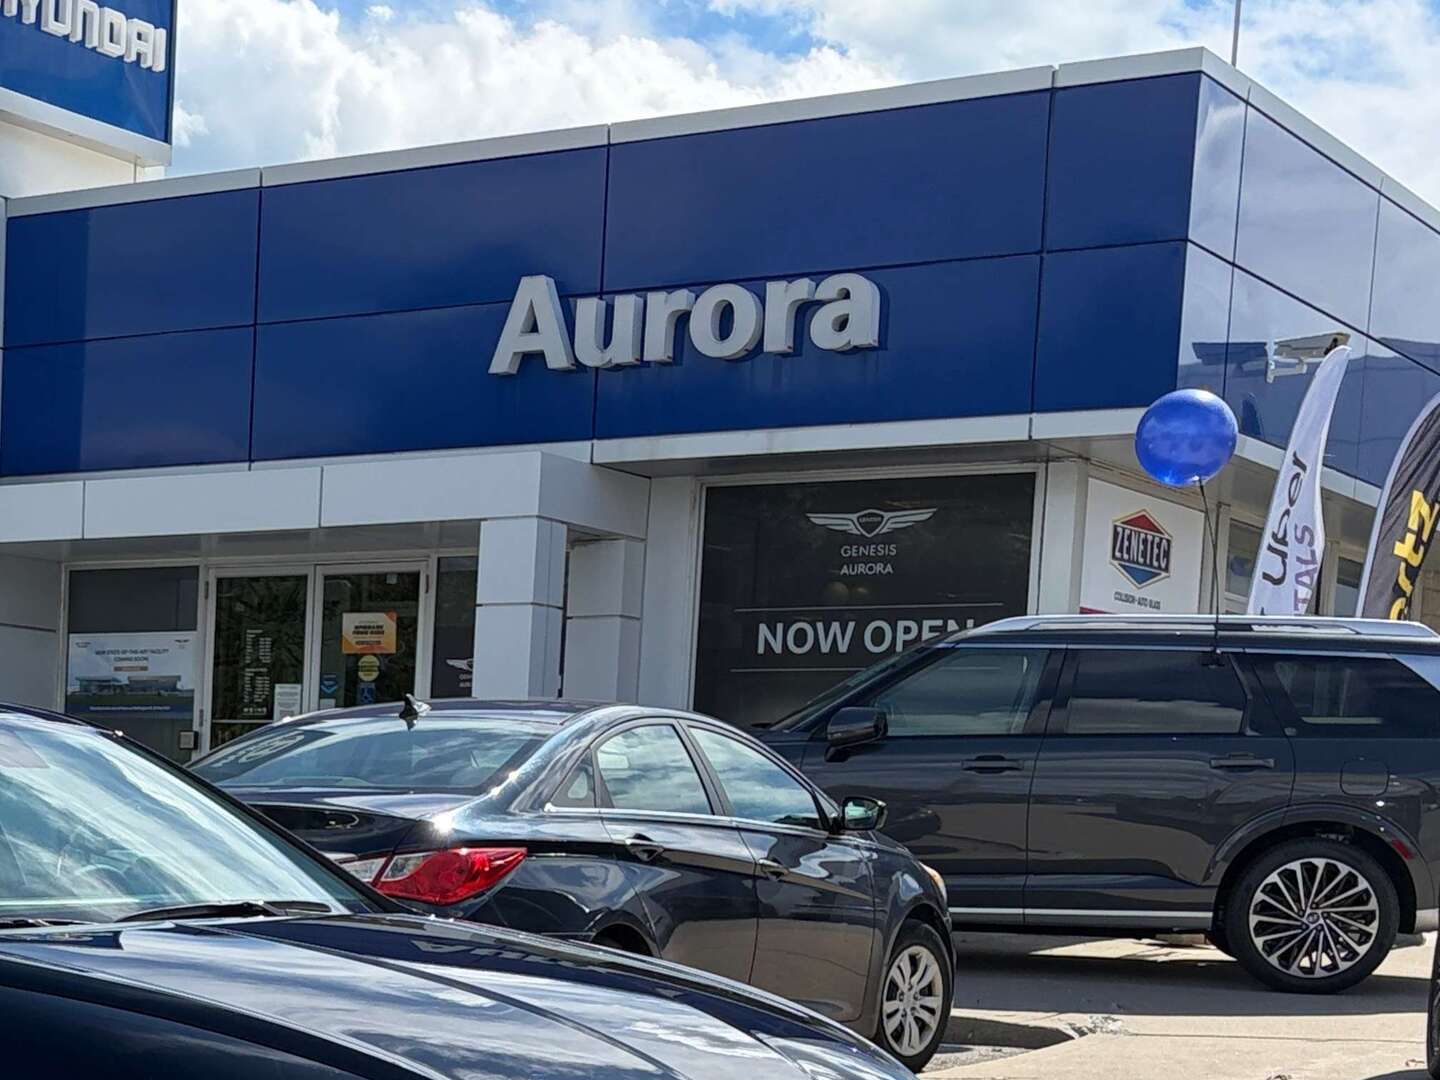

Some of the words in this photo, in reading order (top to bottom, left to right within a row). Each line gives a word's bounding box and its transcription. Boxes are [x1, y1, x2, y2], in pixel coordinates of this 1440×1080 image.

[488, 272, 881, 376] Aurora
[841, 544, 897, 557] GENESIS
[1114, 526, 1168, 569] ZENETEC
[840, 562, 894, 576] AURORA
[1293, 523, 1318, 615] TALS
[757, 620, 857, 655] NOW
